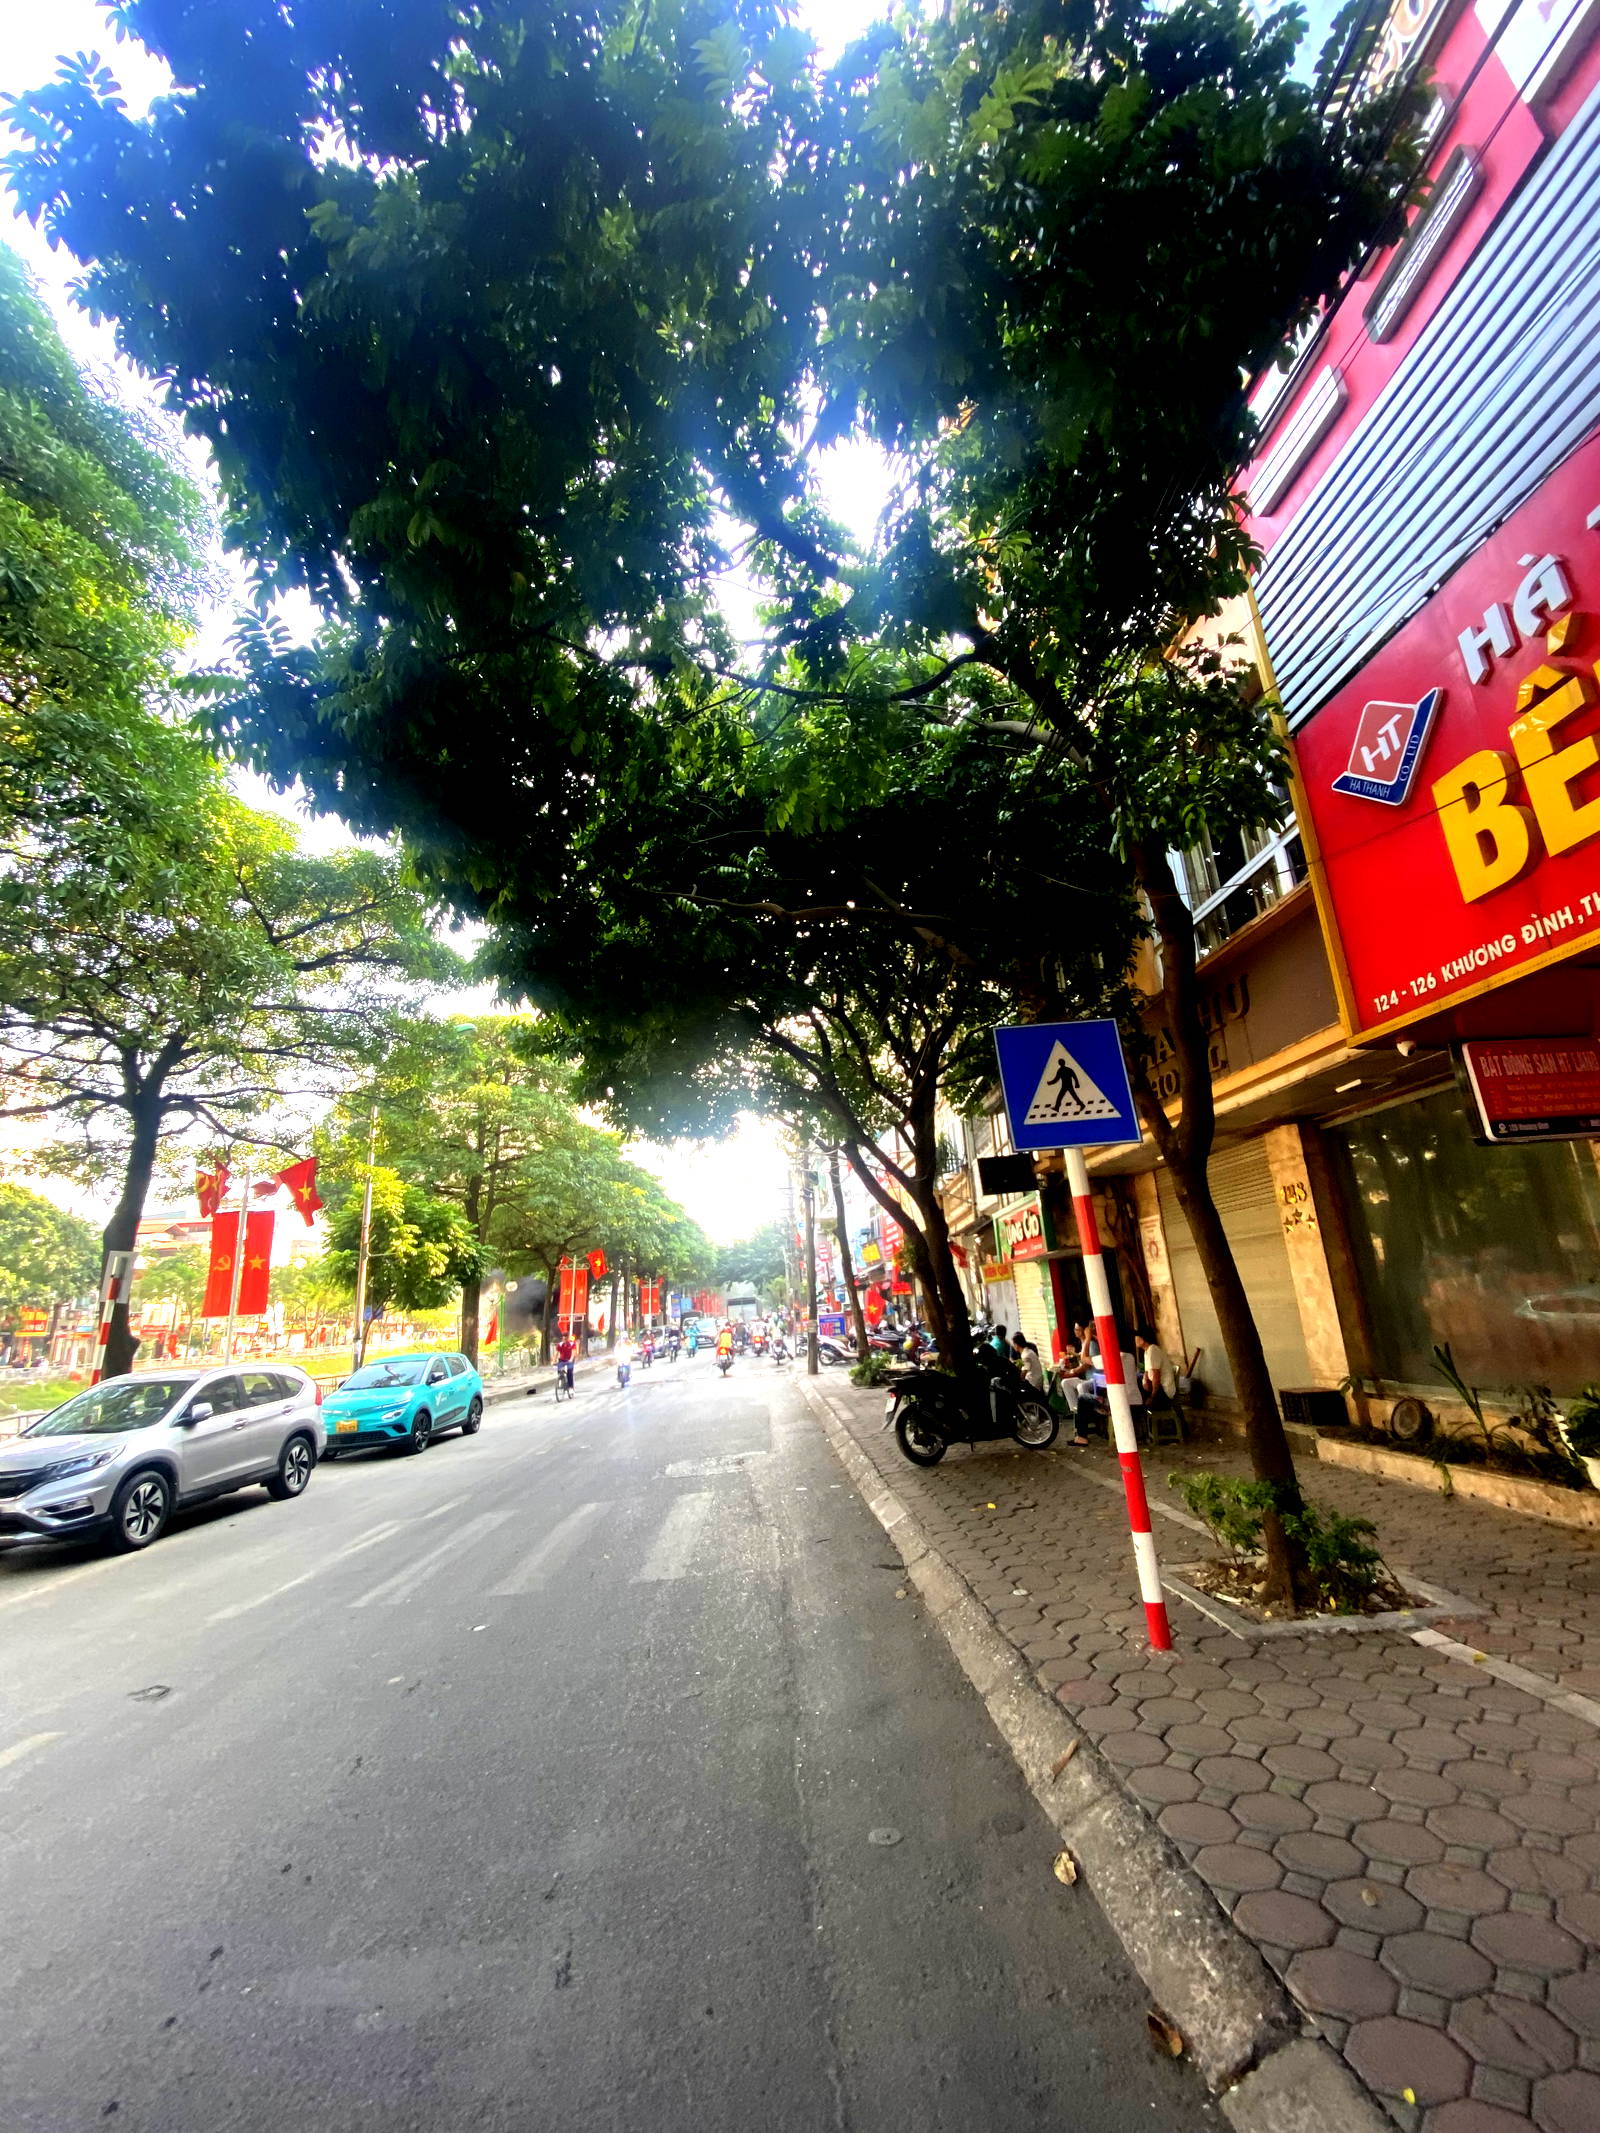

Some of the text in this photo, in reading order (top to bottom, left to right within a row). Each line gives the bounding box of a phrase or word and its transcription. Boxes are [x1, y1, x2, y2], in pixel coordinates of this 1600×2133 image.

[1457, 553, 1573, 685] HÀ
[1360, 714, 1402, 773] HT
[1406, 734, 1421, 756] LTD
[1431, 611, 1600, 904] BẾ
[1361, 780, 1391, 798] THANH
[1374, 988, 1400, 1014] 124
[1410, 972, 1437, 997] 126
[1441, 933, 1517, 983] KHƯƠNG
